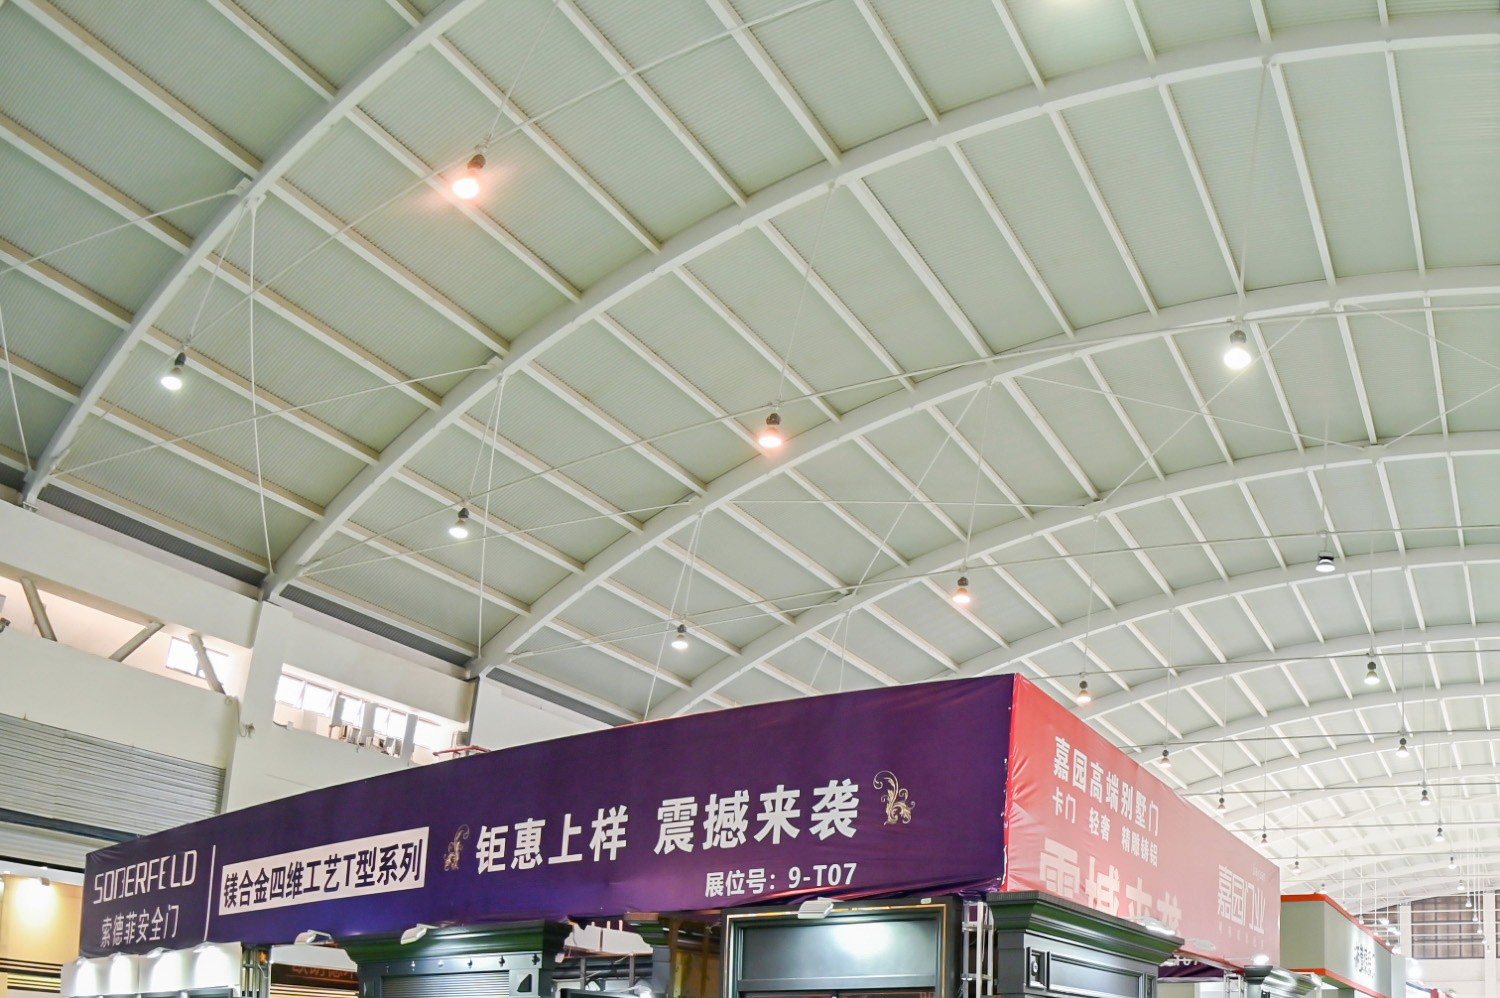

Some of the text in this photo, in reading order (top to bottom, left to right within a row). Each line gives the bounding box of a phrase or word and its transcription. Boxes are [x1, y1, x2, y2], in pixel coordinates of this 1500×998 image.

[654, 779, 860, 855] 震撼来袭
[1052, 786, 1077, 824] 卡门
[1089, 807, 1111, 843] 轻奢
[1053, 736, 1160, 836] 嘉园高端别墅门
[223, 838, 424, 909] 镁合金四维工艺T型系列
[476, 804, 629, 875] 钜惠上样
[101, 903, 179, 949] 索德菲安全门
[1217, 864, 1267, 935] 嘉园门业
